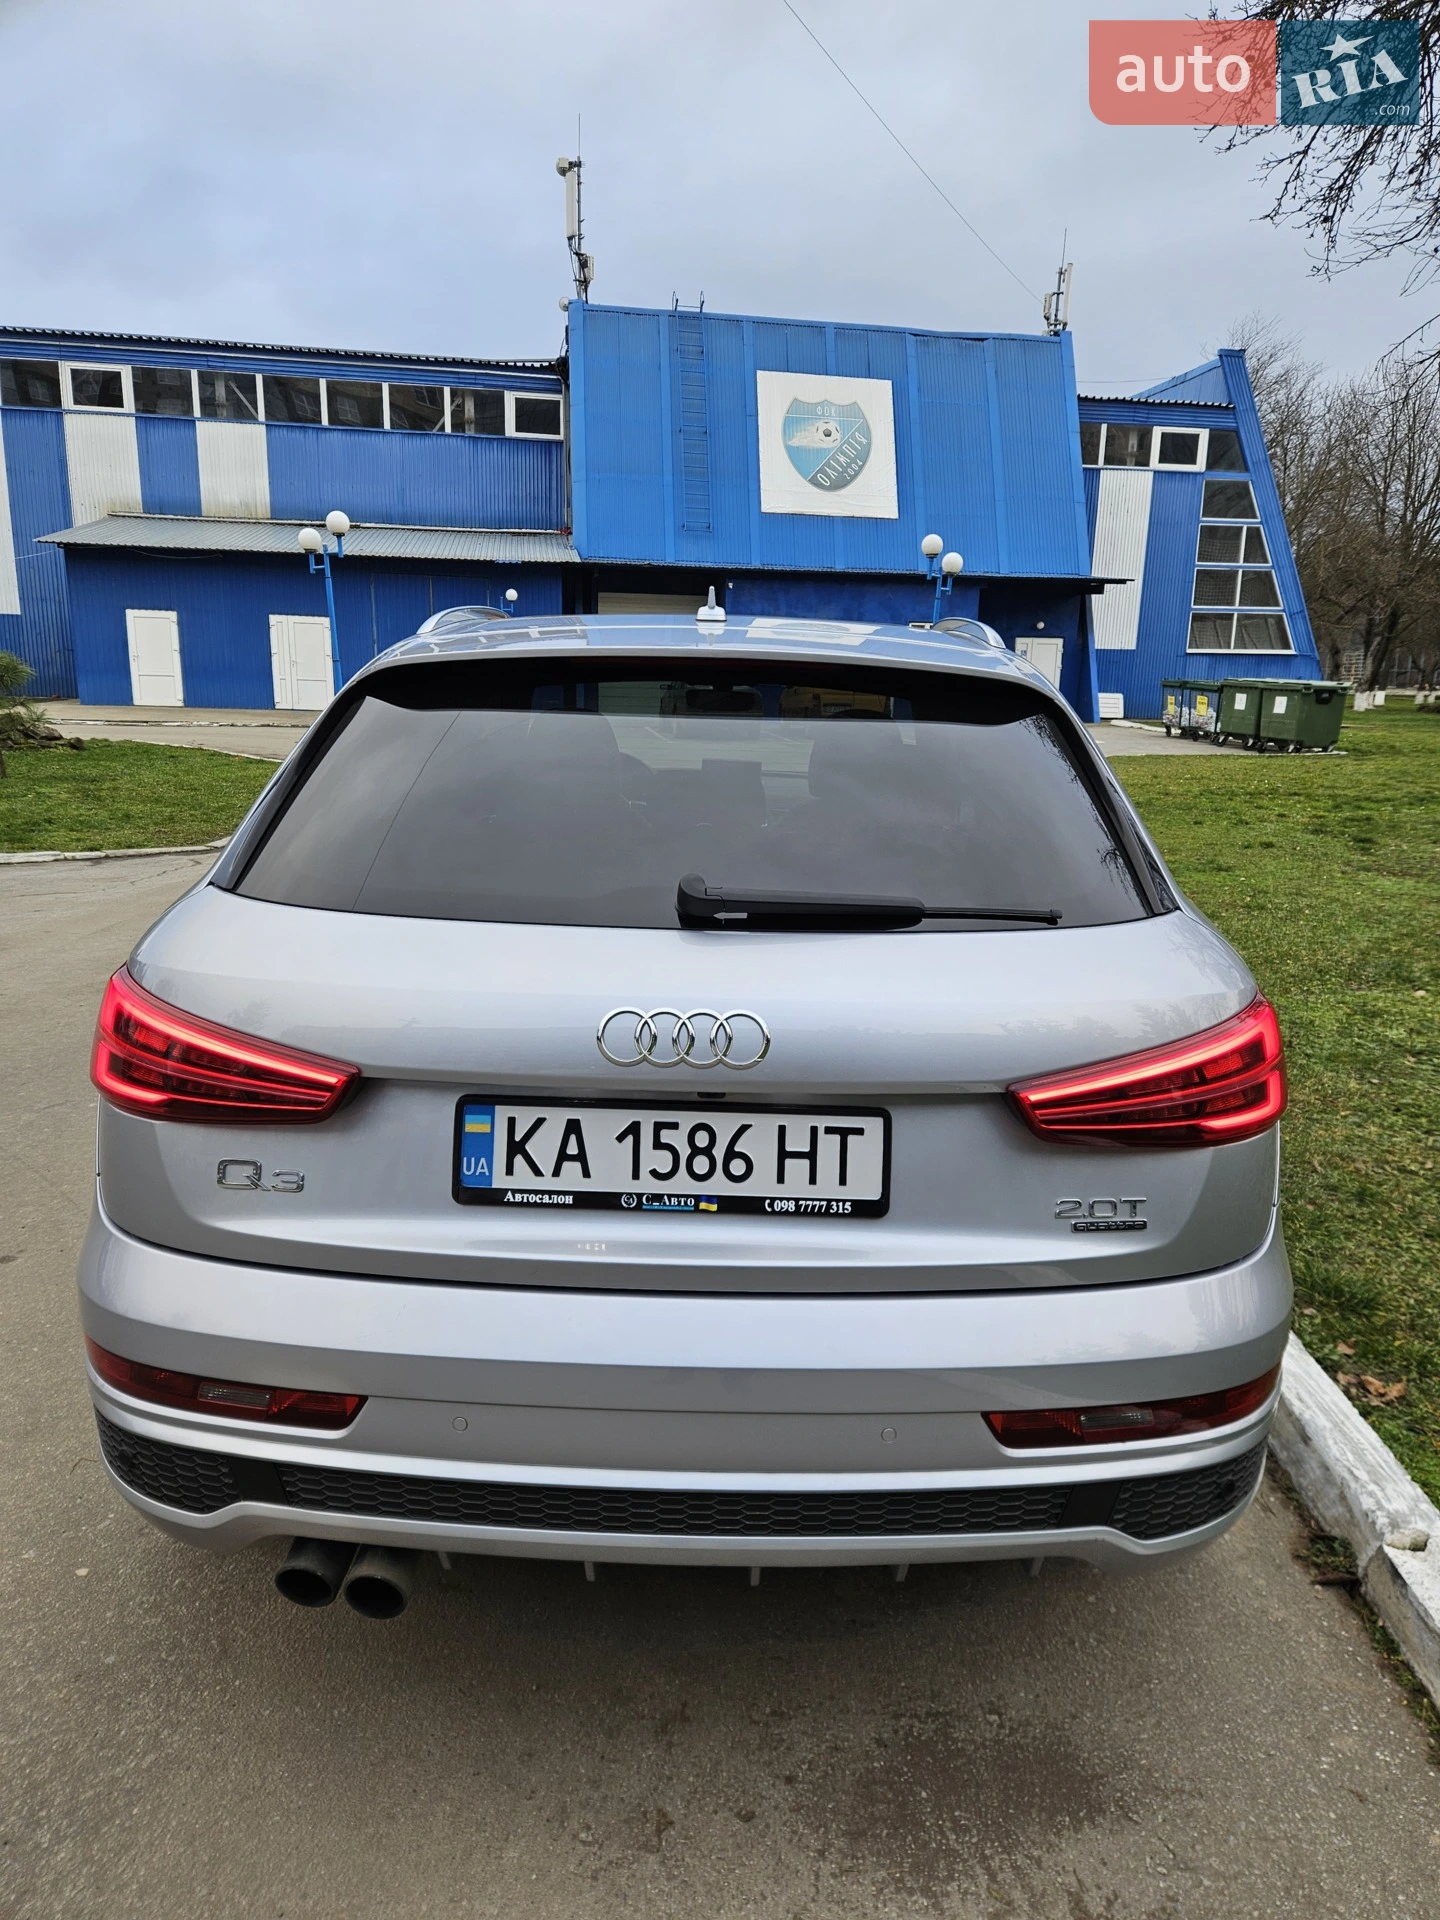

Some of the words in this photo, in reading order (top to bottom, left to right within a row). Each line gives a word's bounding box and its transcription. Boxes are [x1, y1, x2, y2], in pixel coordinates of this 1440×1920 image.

[843, 458, 863, 479] 2004
[614, 1120, 754, 1184] 1586
[217, 1158, 304, 1193] Q3
[463, 1156, 489, 1176] UA
[504, 1190, 573, 1204] Автосалон
[774, 1199, 796, 1212] 098
[799, 1200, 827, 1213] 7777
[829, 1201, 852, 1214] 315
[1055, 1198, 1147, 1219] 2.0T
